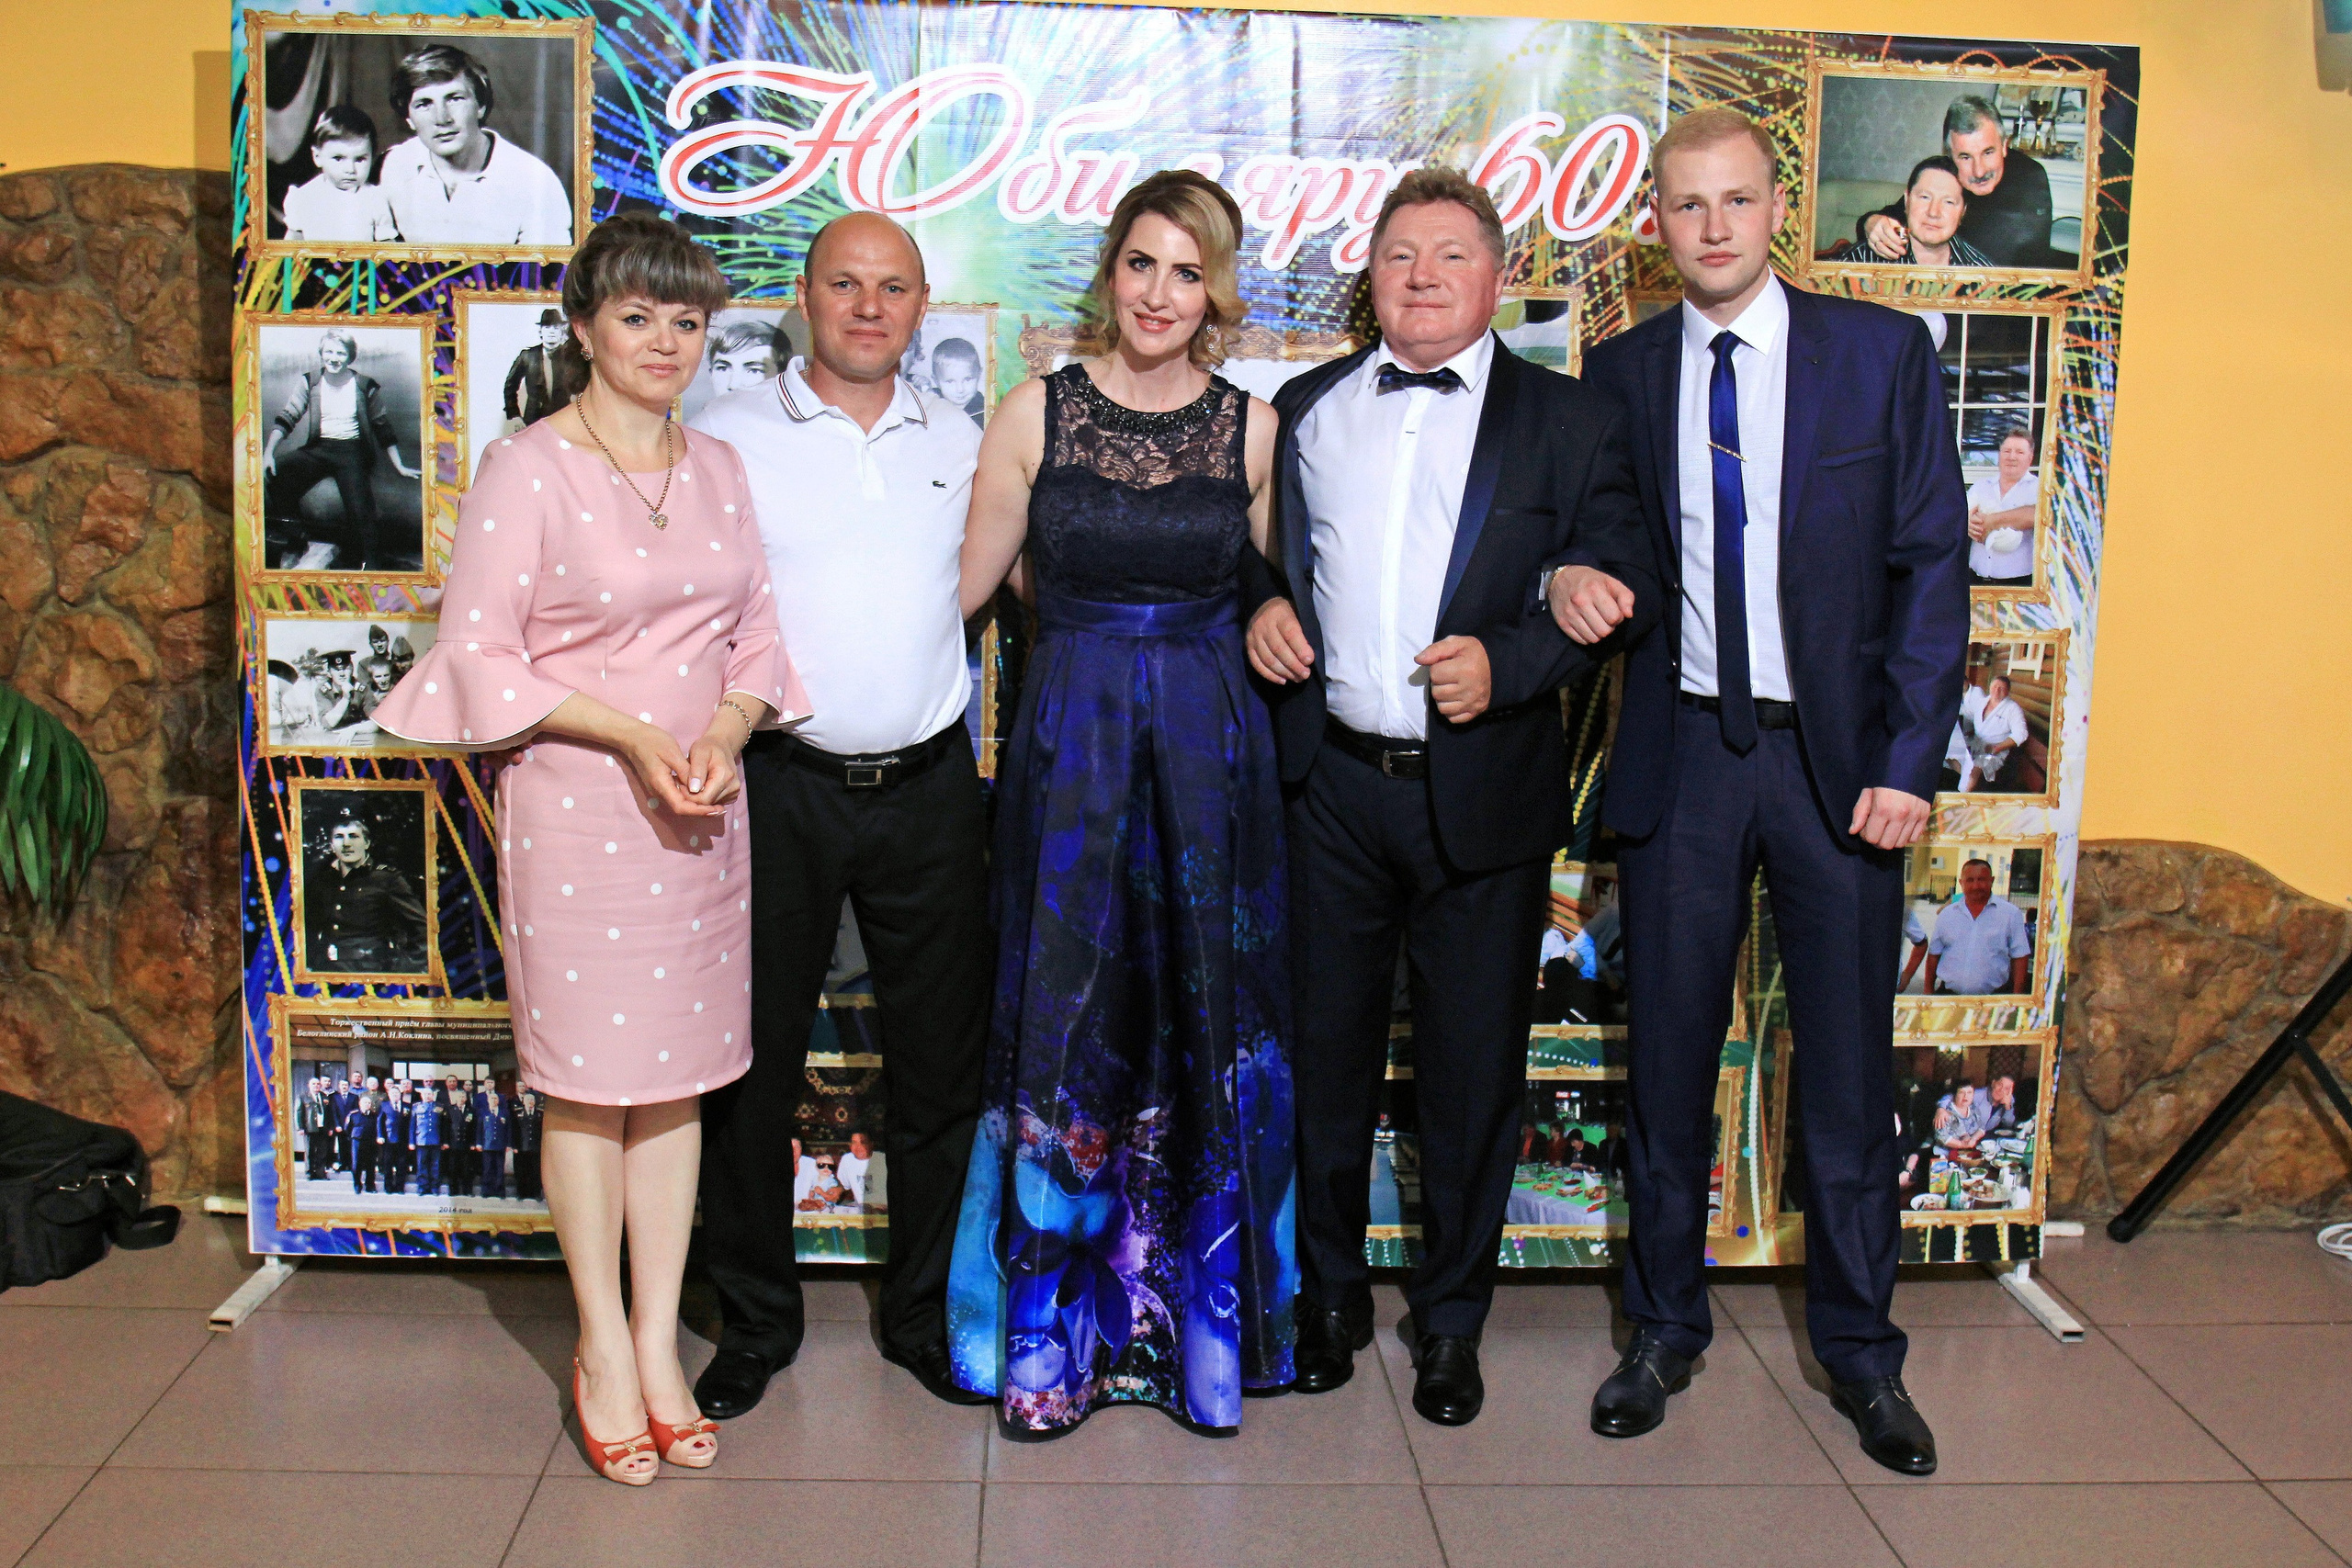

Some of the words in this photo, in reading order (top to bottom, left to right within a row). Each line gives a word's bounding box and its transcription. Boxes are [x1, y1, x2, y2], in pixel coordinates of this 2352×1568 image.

[661, 61, 1419, 273] Юбияру
[330, 1018, 393, 1027] Торжественный
[395, 1020, 419, 1029] приём
[297, 1029, 352, 1037] Белоглинский
